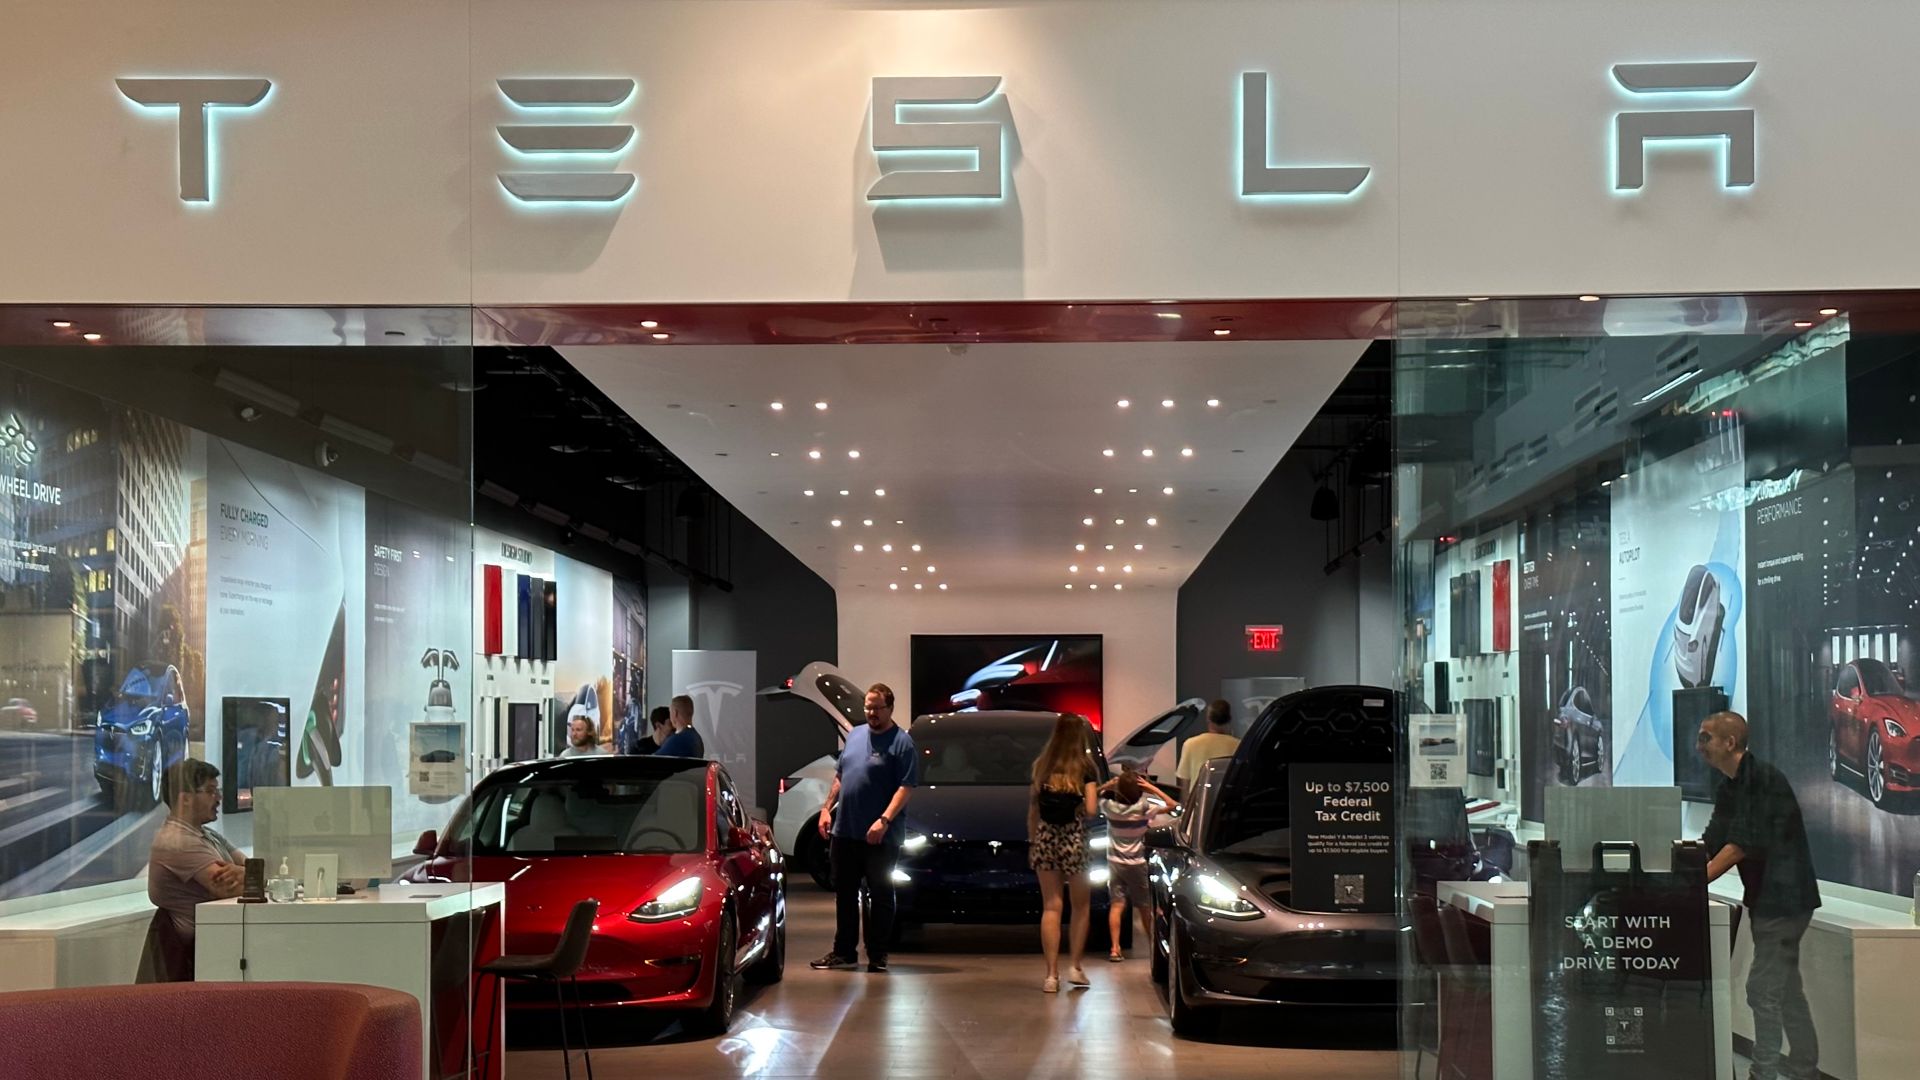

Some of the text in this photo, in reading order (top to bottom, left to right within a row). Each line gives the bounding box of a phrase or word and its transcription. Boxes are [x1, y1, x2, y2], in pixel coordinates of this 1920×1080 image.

[115, 60, 1758, 205] TESLA
[33, 482, 62, 506] DRIVE
[220, 503, 269, 528] FULLY CHARGED
[1757, 496, 1802, 525] PERFORMANCE
[374, 544, 402, 562] SAFETY FIRST
[1254, 632, 1277, 649] EXIT
[1305, 781, 1390, 794] Up to $7,500
[1323, 796, 1372, 807] Federal
[1314, 810, 1381, 821] Tax Credit
[1564, 916, 1671, 929] START WITH
[1584, 936, 1653, 949] A DEMO
[1563, 957, 1680, 970] DRIVE TODAY
